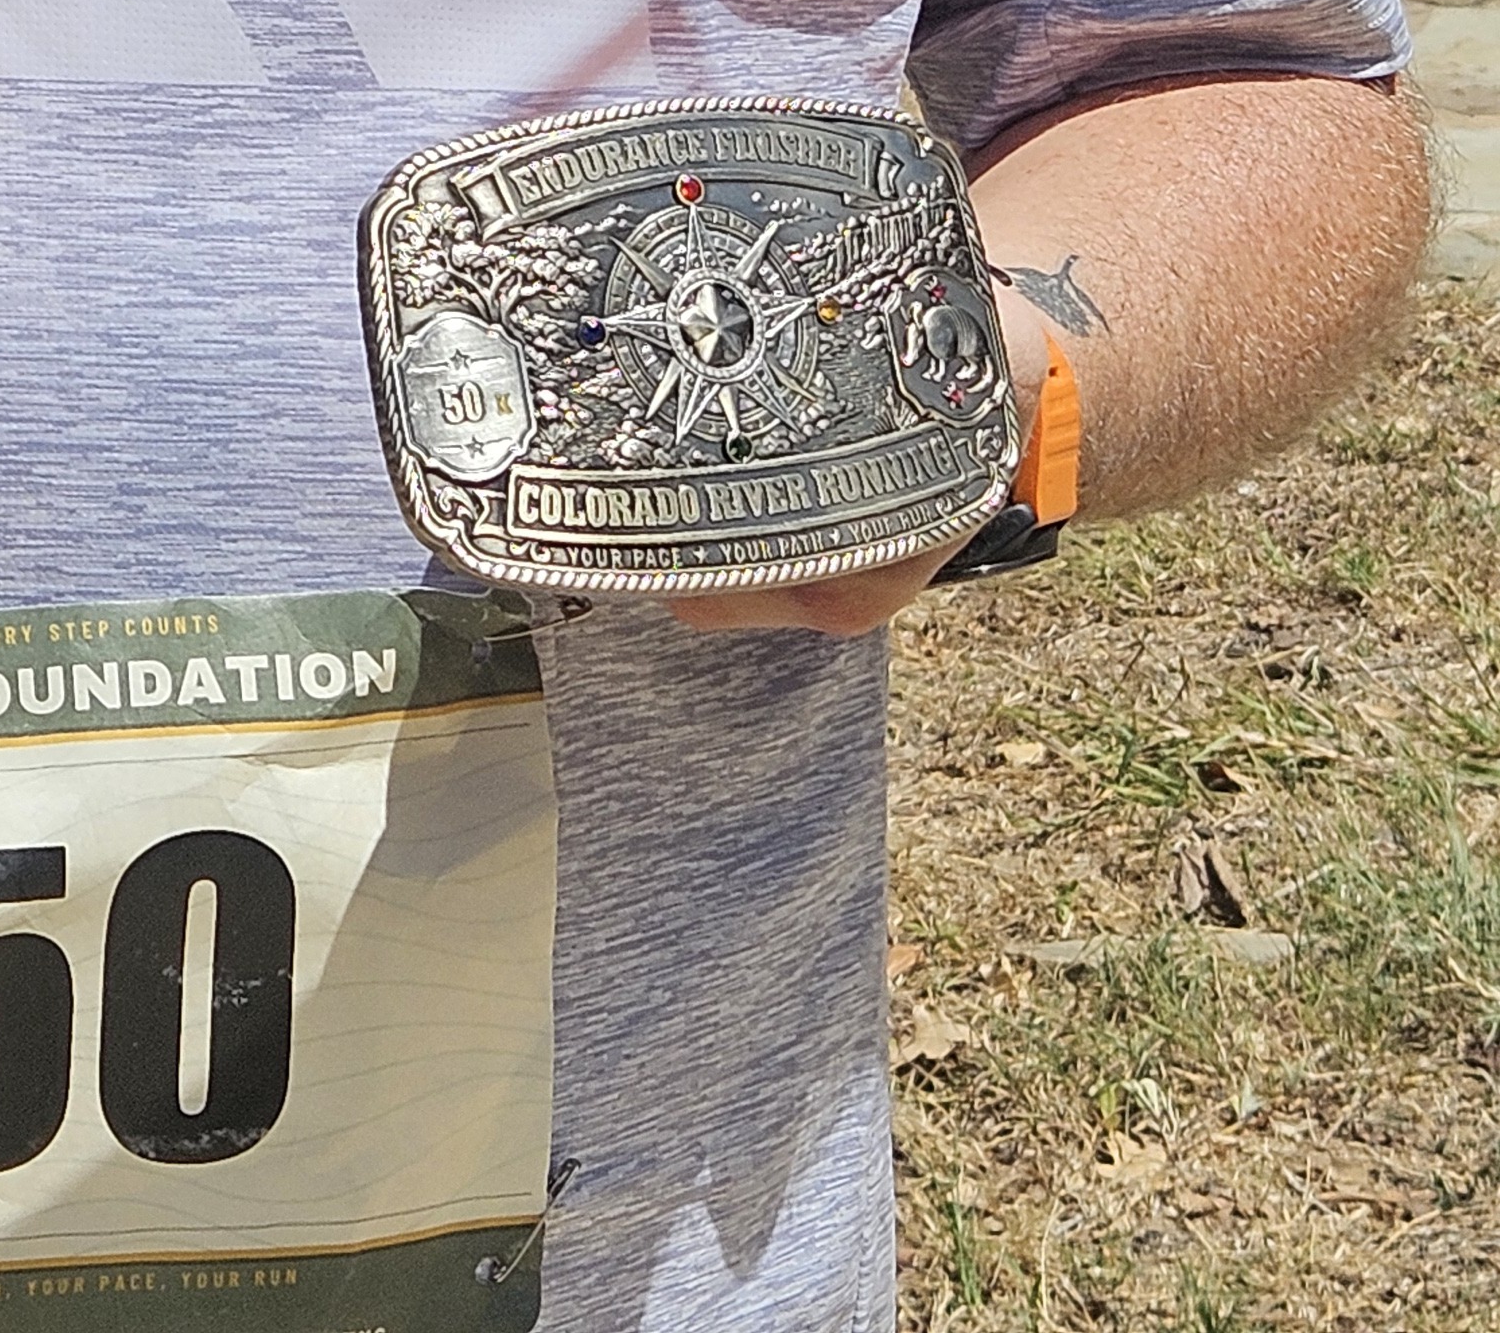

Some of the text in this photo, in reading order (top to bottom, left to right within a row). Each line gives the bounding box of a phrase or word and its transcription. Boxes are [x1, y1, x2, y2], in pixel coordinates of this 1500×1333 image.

[509, 127, 859, 205] ENDURANCE FINISHER
[438, 381, 487, 425] 50
[518, 434, 957, 528] COLORADO RIVER RUNNING
[567, 546, 624, 570] YOUR
[632, 547, 683, 569] PACE
[719, 539, 772, 564] YOUR
[777, 530, 826, 558] PATH
[48, 619, 111, 643] STEP
[124, 613, 220, 637] COUNTS
[27, 1276, 85, 1296] YOUR
[181, 1270, 241, 1289] YOUR
[254, 1268, 297, 1287] RUN
